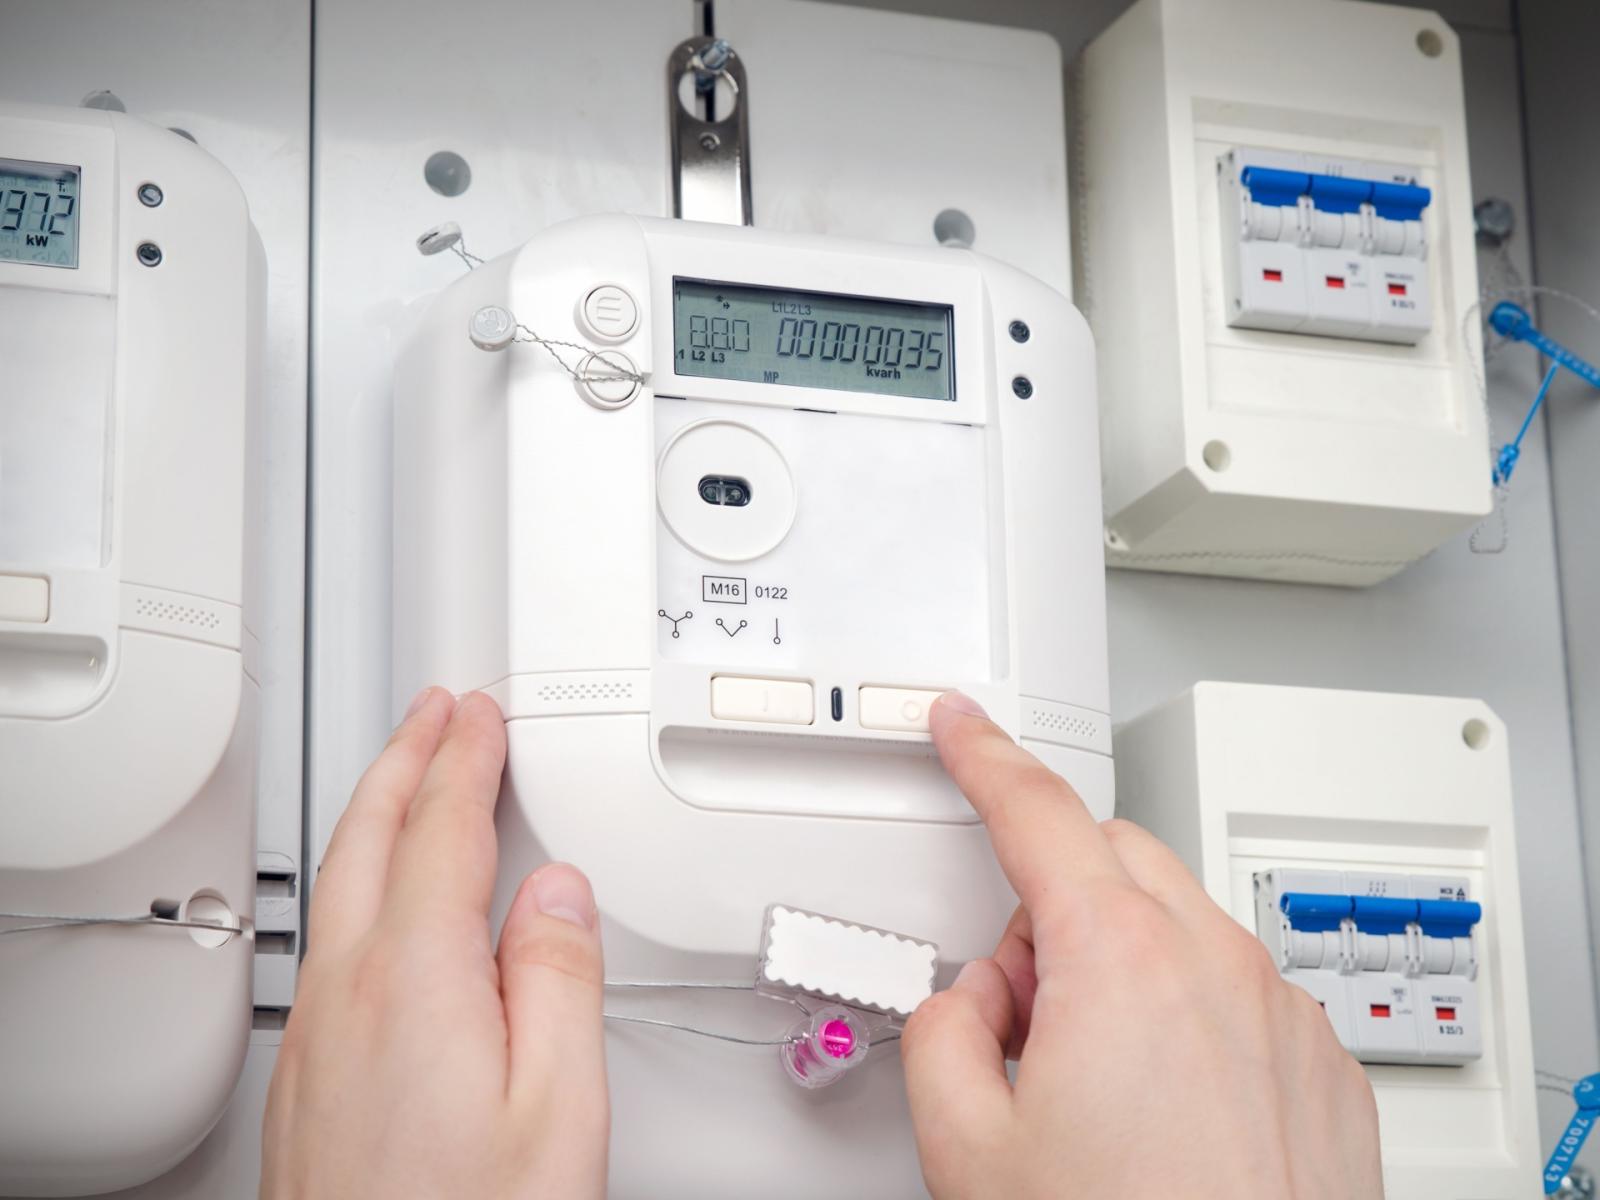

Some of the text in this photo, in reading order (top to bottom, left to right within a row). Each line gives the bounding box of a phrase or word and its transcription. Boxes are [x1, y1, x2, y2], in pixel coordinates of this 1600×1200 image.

[0, 189, 75, 235] 372
[26, 234, 48, 247] kW
[692, 350, 705, 361] L2
[711, 352, 725, 363] L3
[763, 370, 779, 384] MP
[866, 365, 901, 380] kvarh
[711, 582, 788, 599] M16 0122
